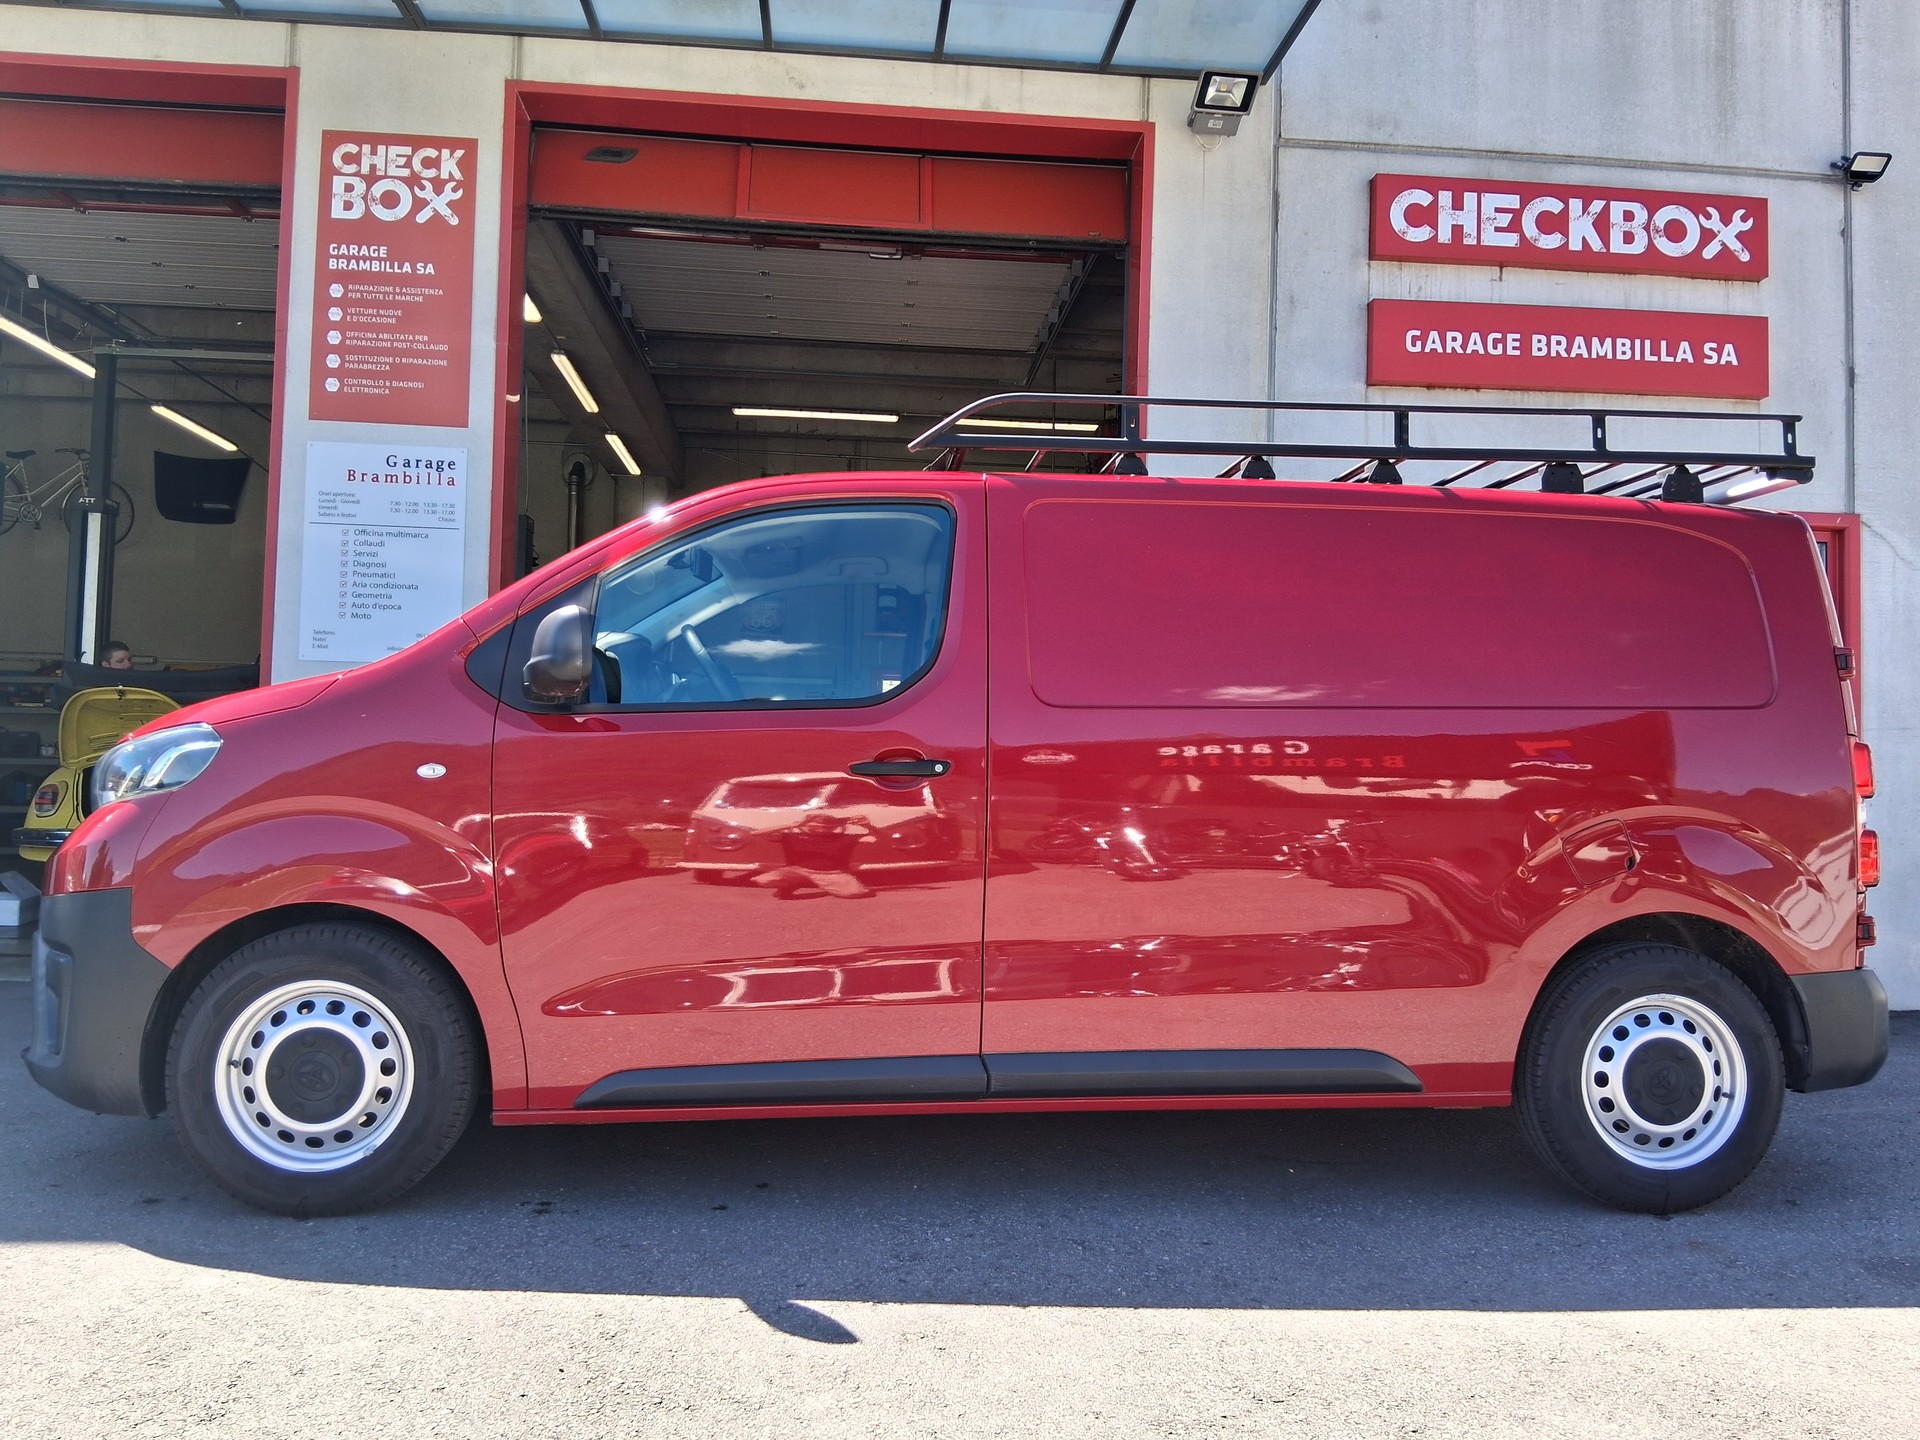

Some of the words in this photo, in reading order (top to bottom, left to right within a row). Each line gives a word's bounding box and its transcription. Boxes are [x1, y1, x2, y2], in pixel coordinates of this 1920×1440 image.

[332, 143, 465, 180] CHECK
[329, 243, 388, 257] GARAGE
[328, 258, 412, 273] BRAMBILLA
[416, 263, 435, 275] SA
[348, 284, 394, 292] RIPARAZIONE
[402, 287, 444, 295] ASSISTENZA
[395, 294, 424, 302] MARCHE
[347, 307, 377, 315] VETTURE
[352, 316, 396, 324] D'OCCASIONE
[346, 331, 377, 339] OFFICINA
[378, 333, 413, 341] ABILITATA
[345, 339, 392, 347] RIPARAZIONE
[393, 341, 449, 351] POST-COLLAUDO
[1405, 329, 1521, 356] GARAGE
[1531, 333, 1694, 363] BRAMBILLA
[1702, 342, 1739, 366] SA
[345, 354, 393, 363] SOSTITUZIONE
[401, 358, 448, 366] RIPARAZIONE
[344, 362, 390, 371] PARABREZZA
[344, 378, 384, 386] CONTROLLO
[392, 381, 424, 389] DIAGNOSI
[344, 386, 390, 394] ELETTRONICA
[386, 454, 456, 472] Garage
[347, 469, 456, 486] Brambilla
[353, 528, 384, 537] Officina
[385, 531, 429, 539] multimarca
[353, 539, 385, 547] Collaudi
[353, 549, 378, 557] Servizi
[352, 560, 387, 569] Diagnosi
[352, 570, 396, 579] Pneumatici
[369, 582, 419, 590] condizionata
[351, 591, 393, 600] Geometria
[371, 602, 402, 611] d'epoca
[350, 612, 372, 620] Moto
